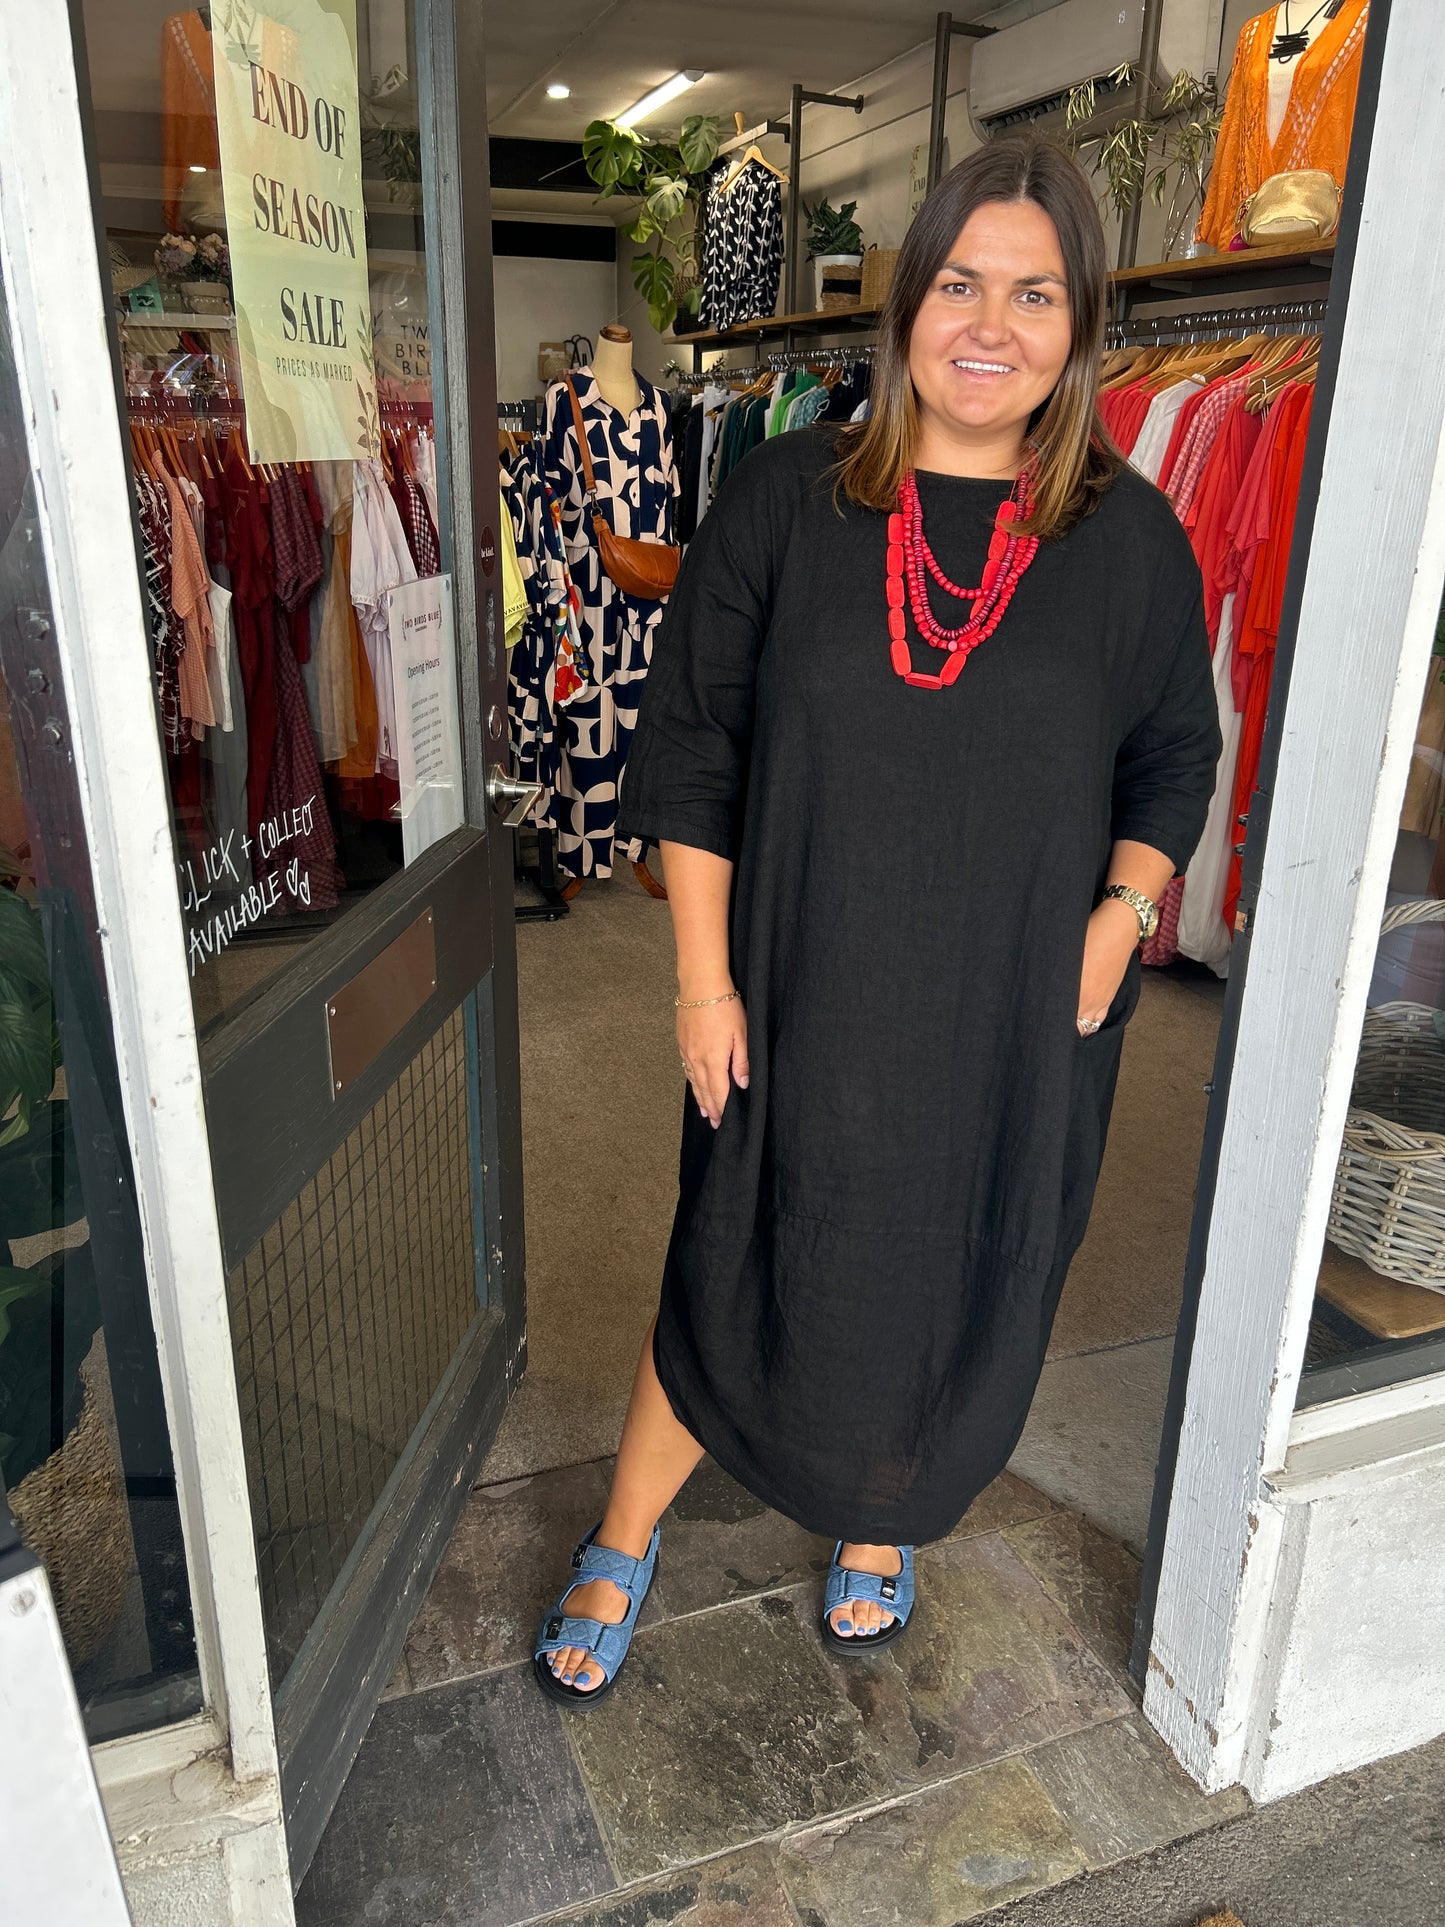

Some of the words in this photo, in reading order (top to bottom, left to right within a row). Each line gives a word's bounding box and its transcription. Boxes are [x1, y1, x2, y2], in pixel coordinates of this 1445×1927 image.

[248, 60, 309, 139] END
[314, 98, 346, 160] OF
[252, 173, 355, 259] SEASON
[280, 287, 347, 348] SALE
[401, 325, 428, 339] TW
[275, 357, 307, 377] PRICES
[310, 361, 321, 378] AS
[323, 363, 353, 381] MARKED
[395, 343, 426, 358] BIR
[404, 619, 414, 629] TWO
[414, 613, 427, 626] BIRDS
[428, 610, 439, 621] BLUE
[408, 663, 425, 679] Opening
[425, 657, 440, 671] Hours
[259, 795, 316, 858] COLLECT
[189, 871, 282, 977] AVAILABLE
